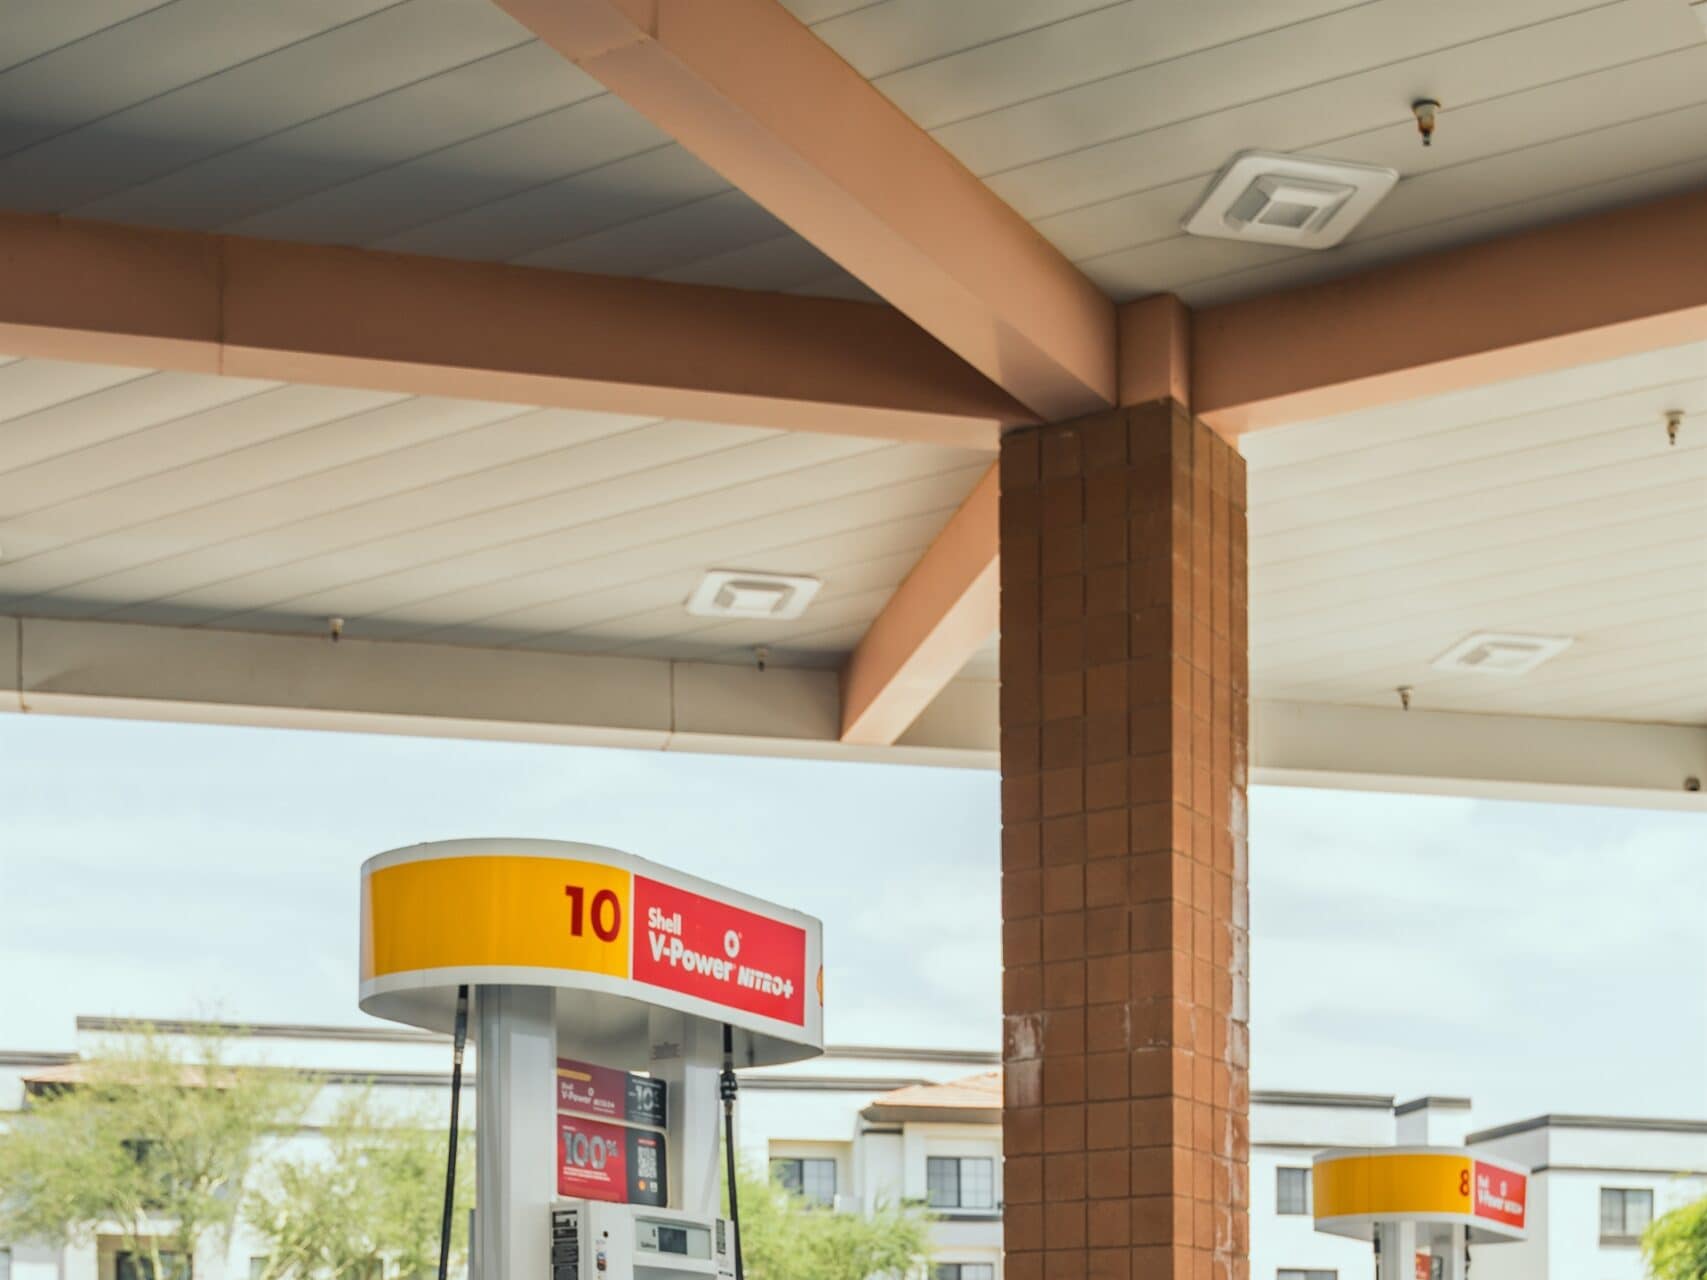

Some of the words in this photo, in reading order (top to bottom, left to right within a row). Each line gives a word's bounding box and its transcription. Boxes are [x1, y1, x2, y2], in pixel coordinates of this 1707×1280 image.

[565, 886, 621, 942] 10
[648, 907, 682, 935] Shell
[649, 929, 733, 982] V-Power
[1459, 1169, 1471, 1196] 8
